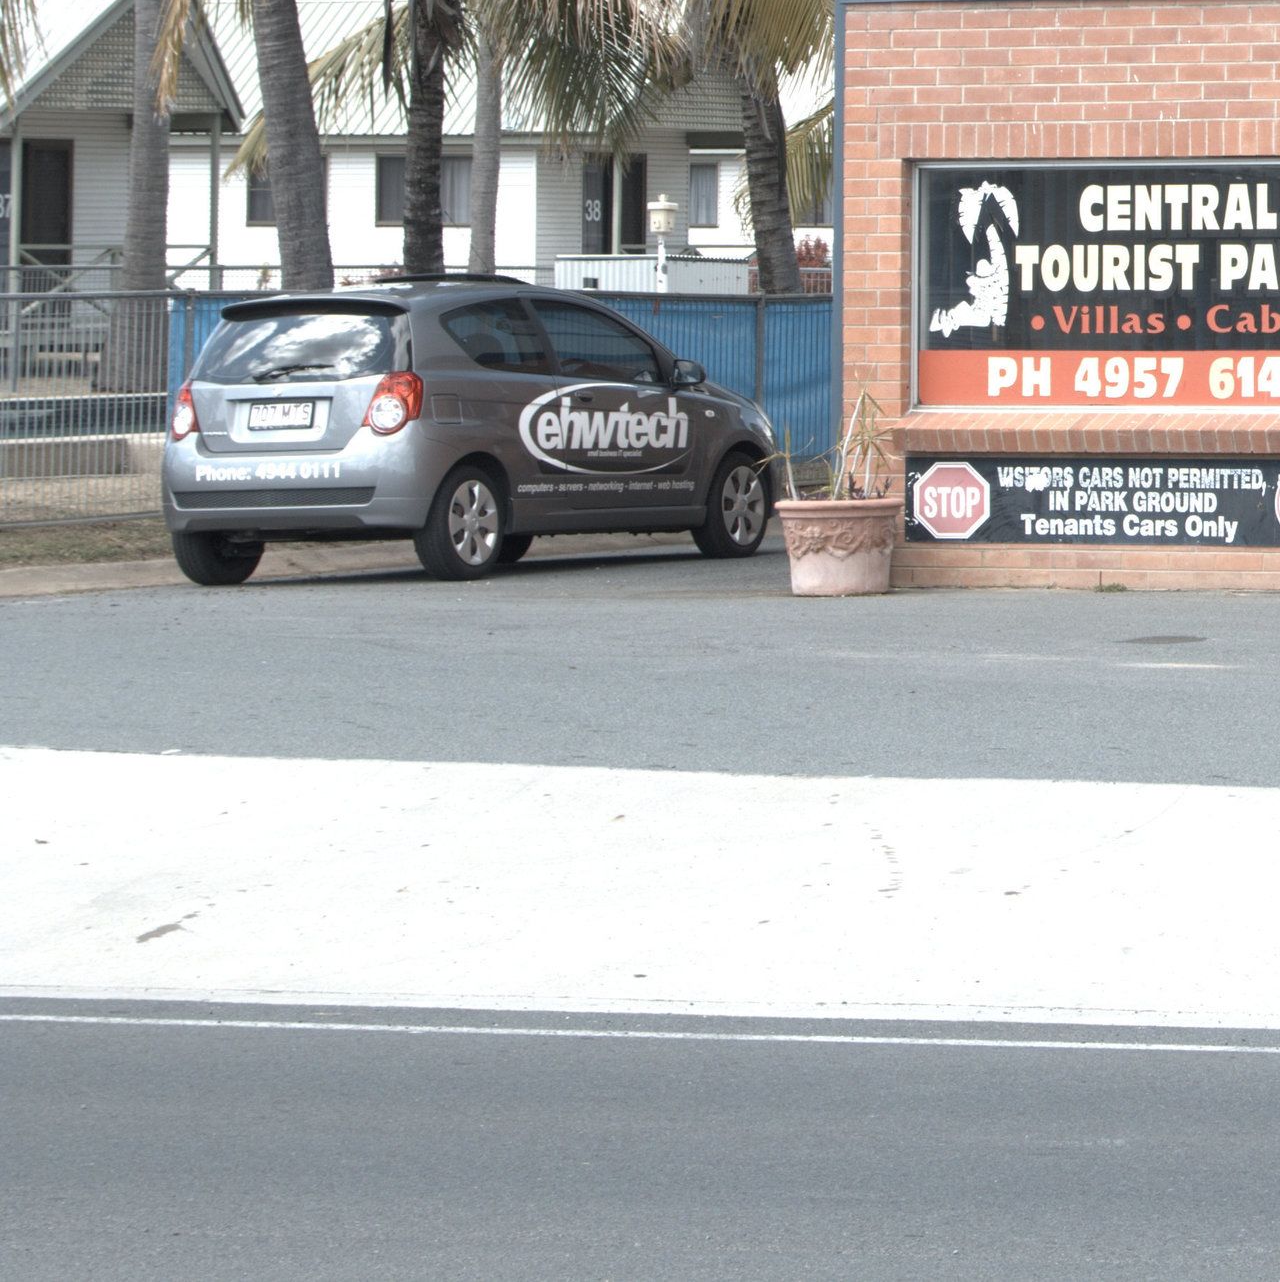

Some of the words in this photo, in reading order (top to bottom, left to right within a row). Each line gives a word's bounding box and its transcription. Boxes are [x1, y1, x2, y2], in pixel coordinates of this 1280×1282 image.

[585, 199, 601, 222] 38
[1079, 183, 1278, 233] CENTRAL
[1015, 244, 1200, 293] TOURIST
[1053, 305, 1166, 335] Villas
[987, 356, 1051, 398] PH
[1074, 356, 1185, 399] 4957
[537, 397, 690, 450] ehwtech
[195, 464, 252, 482] Phone:
[299, 461, 341, 479] 0111
[517, 483, 554, 494] computers
[558, 483, 584, 492] servers
[587, 481, 624, 493] networking
[628, 480, 654, 491] internet
[657, 479, 671, 490] web
[672, 479, 695, 492] hosting
[1079, 467, 1124, 489] CARS
[1128, 467, 1163, 489] NOT
[924, 487, 981, 519] STOP
[1049, 491, 1069, 512] IN
[1075, 491, 1128, 512] PARK
[1133, 491, 1218, 513] GROUND
[1021, 513, 1116, 536] Tenants
[1123, 513, 1178, 536] Cars
[1185, 516, 1239, 544] Only
